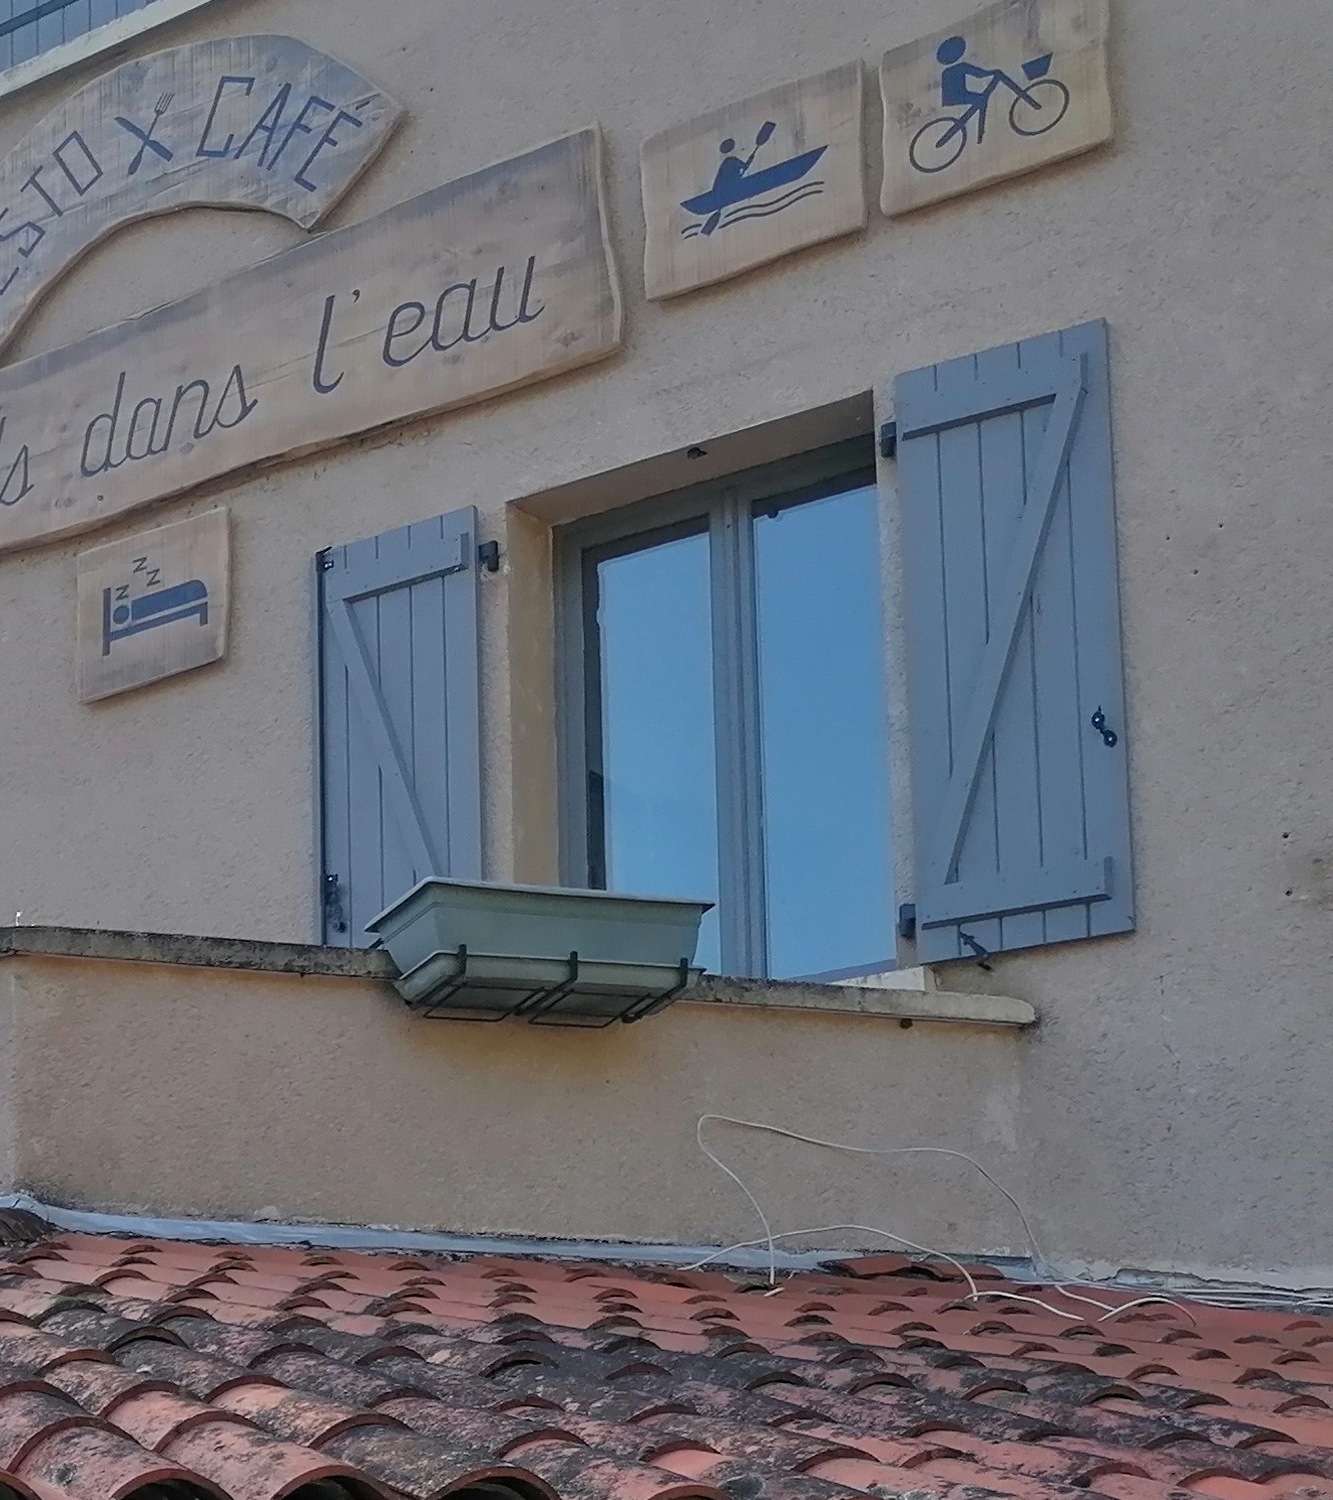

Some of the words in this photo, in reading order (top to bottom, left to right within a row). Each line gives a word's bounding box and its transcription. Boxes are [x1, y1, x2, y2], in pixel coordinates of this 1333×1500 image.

[194, 75, 372, 193] CAFÉ
[79, 364, 259, 478] dans
[312, 255, 546, 395] l'eau
